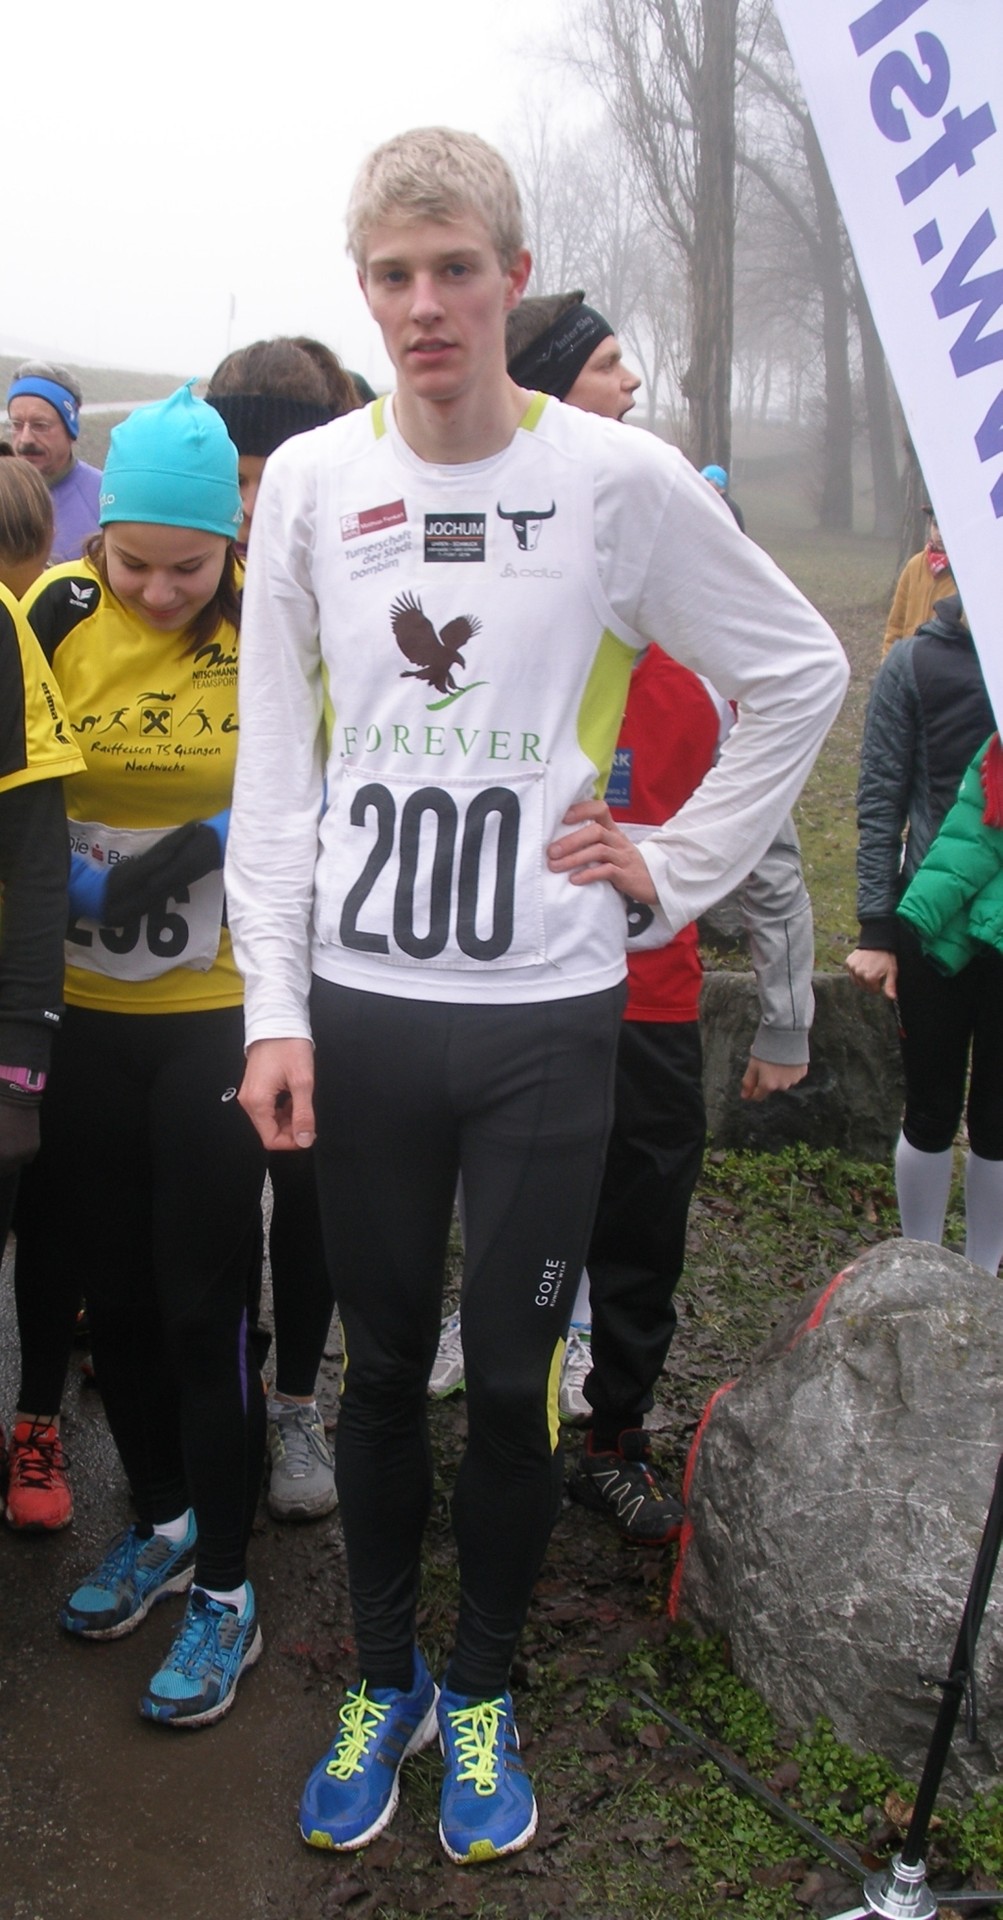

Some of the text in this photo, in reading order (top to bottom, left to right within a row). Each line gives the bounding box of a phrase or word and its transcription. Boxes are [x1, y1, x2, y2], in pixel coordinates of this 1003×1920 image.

[425, 521, 485, 536] JOCHUM
[41, 681, 58, 720] erima
[192, 676, 238, 690] TEAMSPORT
[90, 741, 221, 758] Raiffeisen TS Gisingen
[342, 724, 543, 763] FOREVER
[125, 758, 186, 773] Nachwuchs
[339, 782, 521, 962] 200
[534, 1258, 560, 1307] GORE
[549, 1260, 567, 1307] RUNNING WEAR
